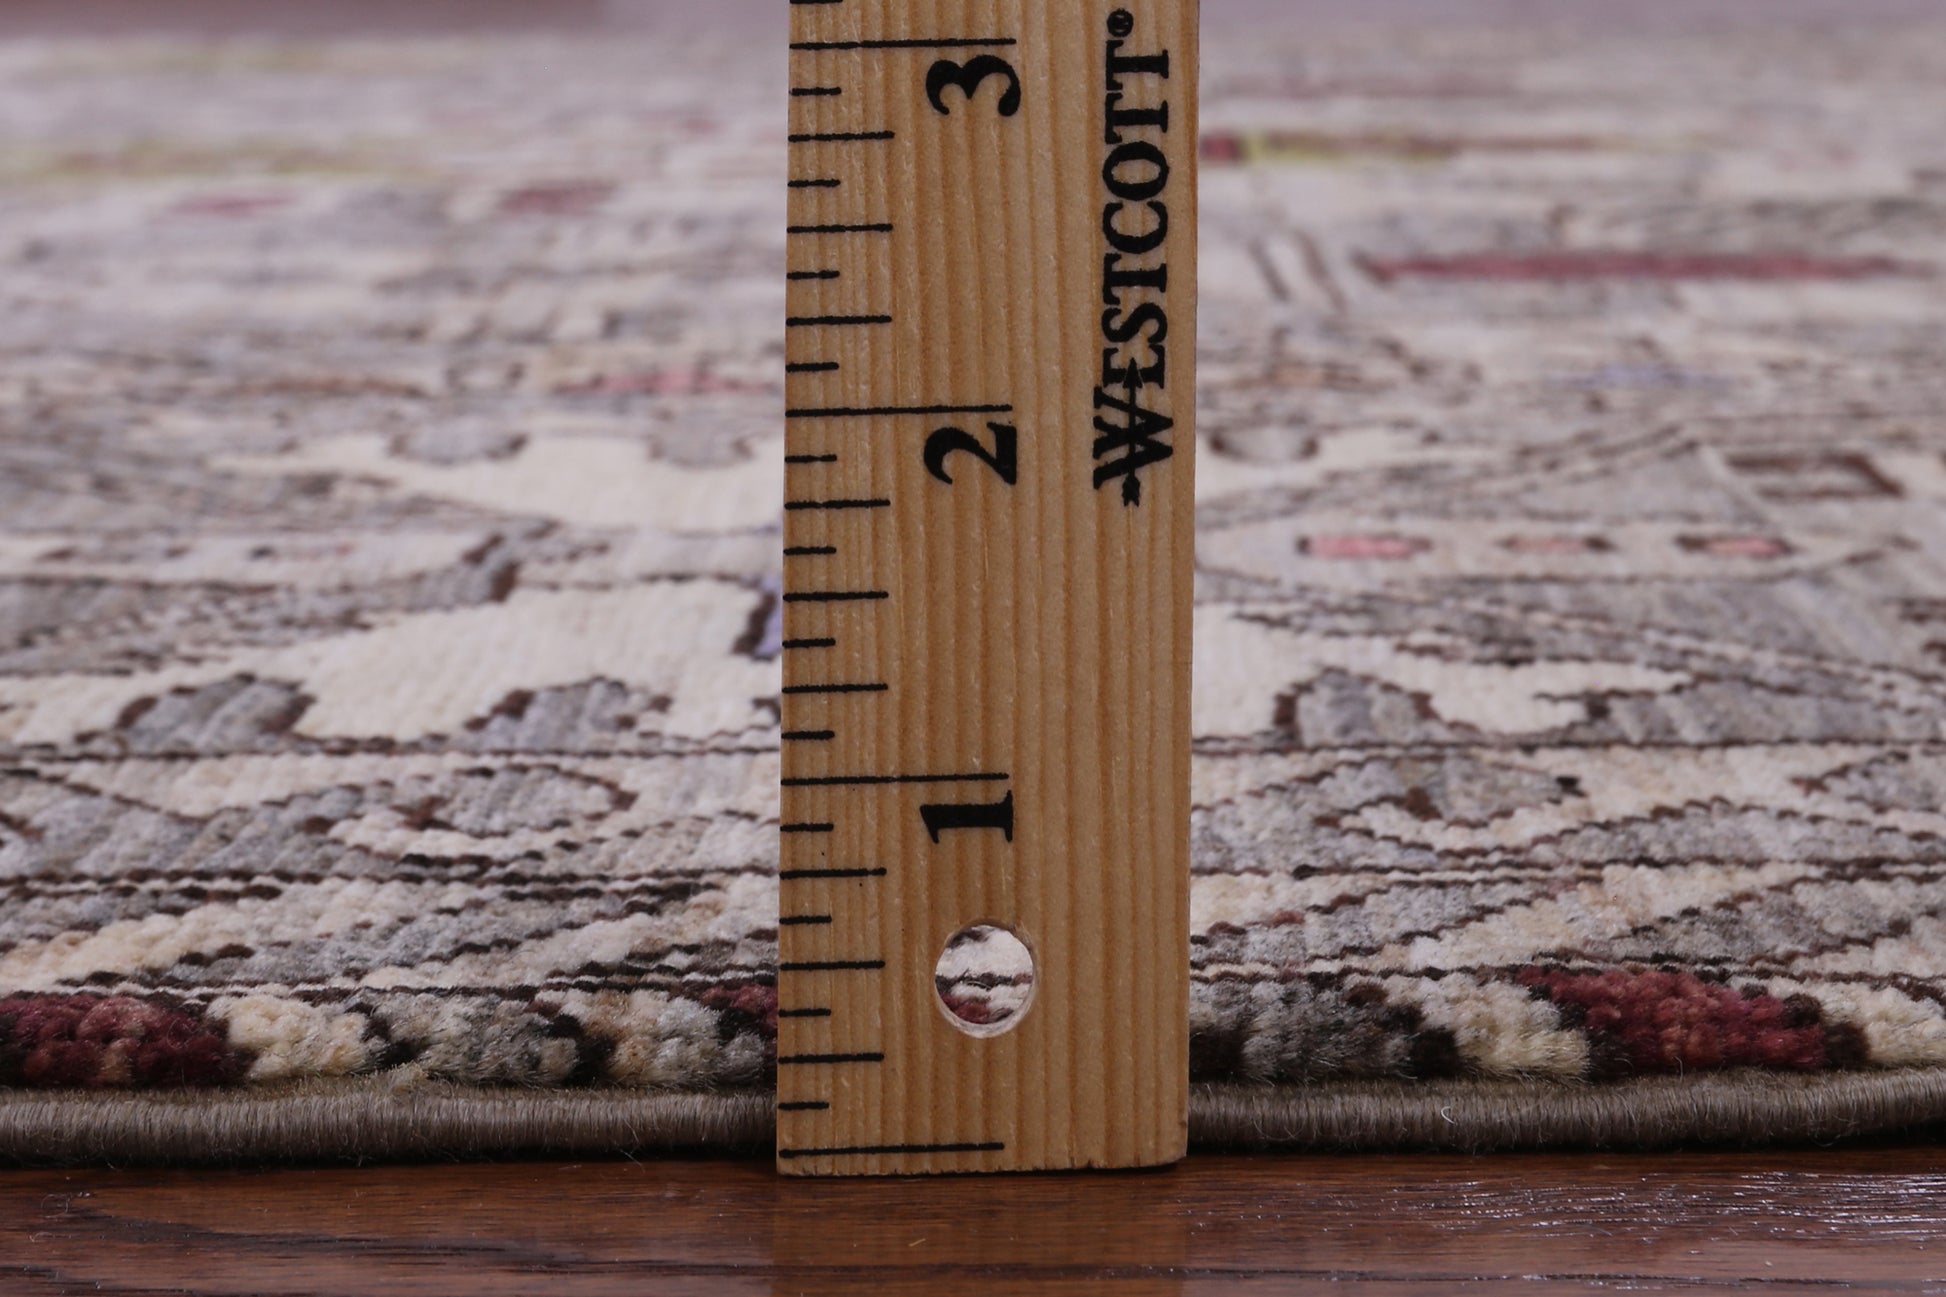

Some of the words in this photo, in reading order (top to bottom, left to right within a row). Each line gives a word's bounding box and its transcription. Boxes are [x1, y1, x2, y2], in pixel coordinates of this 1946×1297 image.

[925, 53, 1022, 118] 3
[922, 419, 1020, 488] 2
[919, 789, 1014, 844] 1
